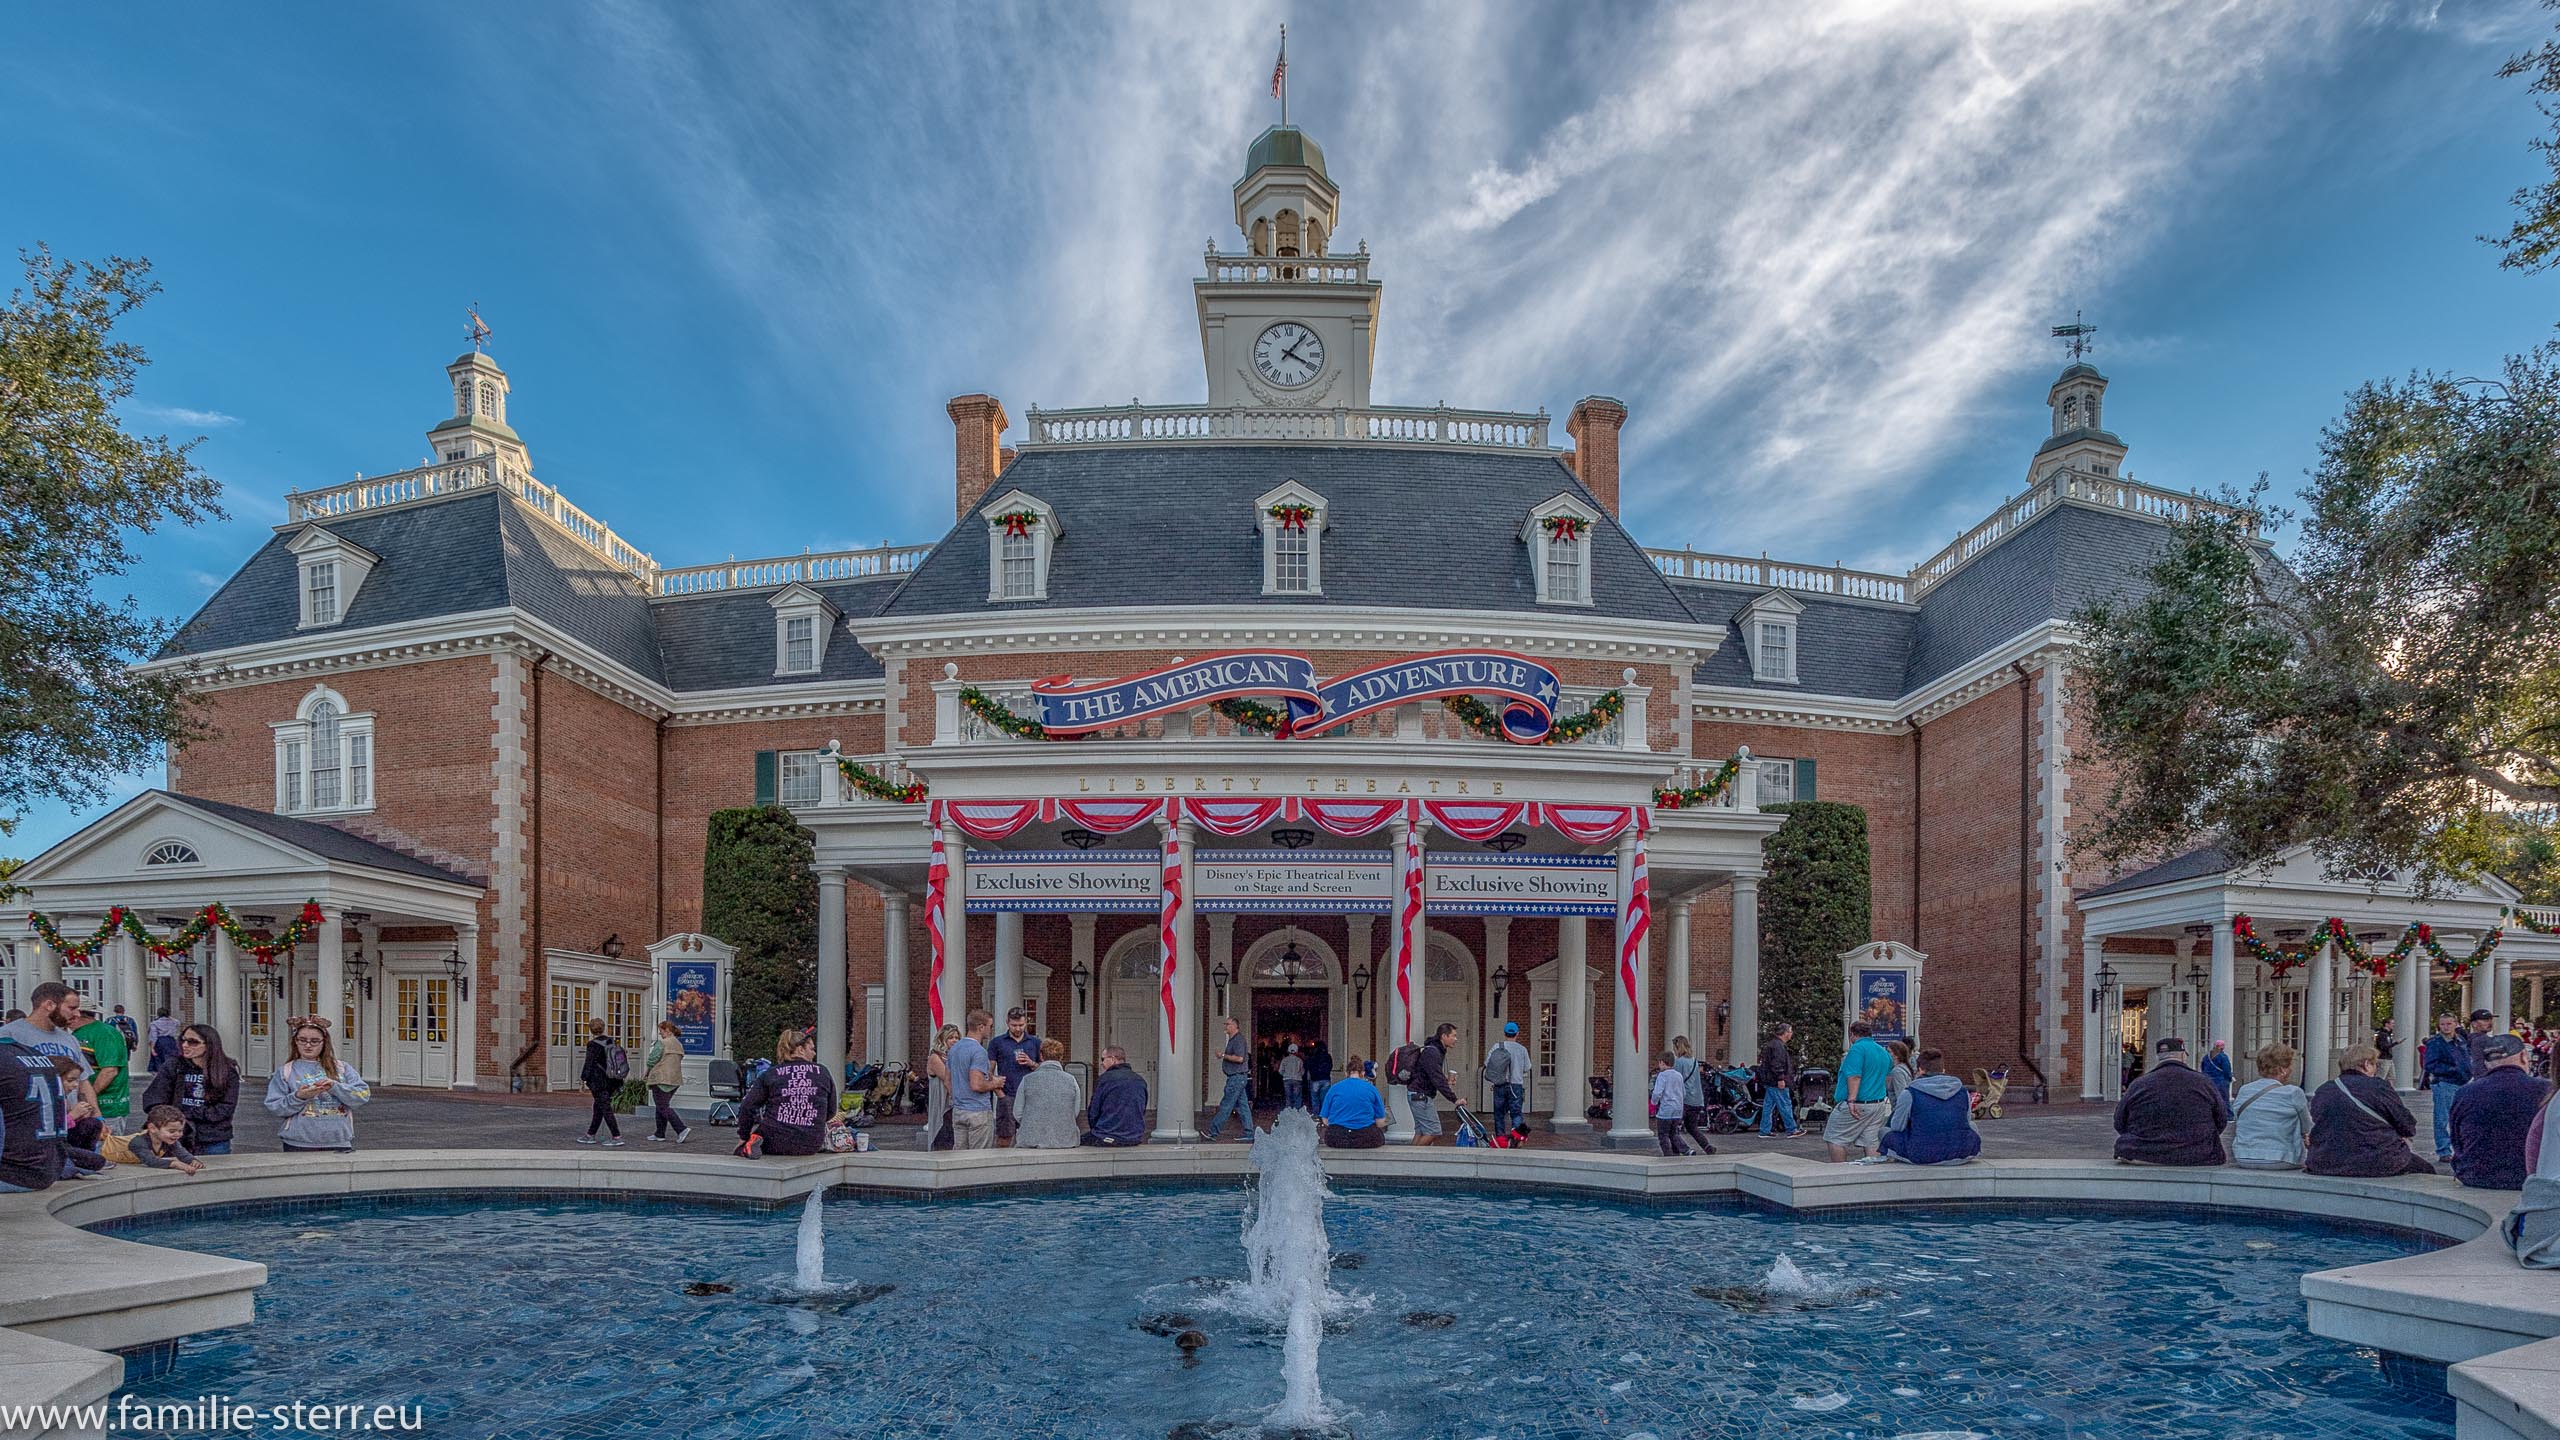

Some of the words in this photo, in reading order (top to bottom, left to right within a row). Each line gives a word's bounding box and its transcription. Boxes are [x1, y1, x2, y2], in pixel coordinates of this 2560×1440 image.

[1062, 691, 1125, 722] THE
[1131, 660, 1289, 709] AMERICAN
[1347, 660, 1528, 708] ADVENTURE
[1079, 777, 1261, 792] LIBERTY
[1307, 778, 1504, 796] THEATRE
[1206, 869, 1253, 881] Disney's
[1257, 870, 1282, 882] Epic
[1285, 869, 1344, 880] Theatrical
[1347, 870, 1380, 880] Event
[975, 873, 1063, 890] Exclusive
[1068, 873, 1151, 893] Showing
[1253, 882, 1283, 894] Stage
[1287, 882, 1309, 893] and
[1313, 882, 1353, 893] Screen
[1435, 875, 1524, 892] Exclusive
[1529, 876, 1608, 898] Showing
[776, 1065, 792, 1076] WE
[792, 1064, 821, 1075] DON'T
[791, 1072, 807, 1080] LET
[788, 1079, 812, 1087] FEAR
[781, 1087, 818, 1097] DISTORT
[790, 1095, 809, 1103] OUR
[778, 1106, 804, 1117] FAITH
[806, 1109, 818, 1118] OR
[777, 1112, 815, 1126] DREAMS.
